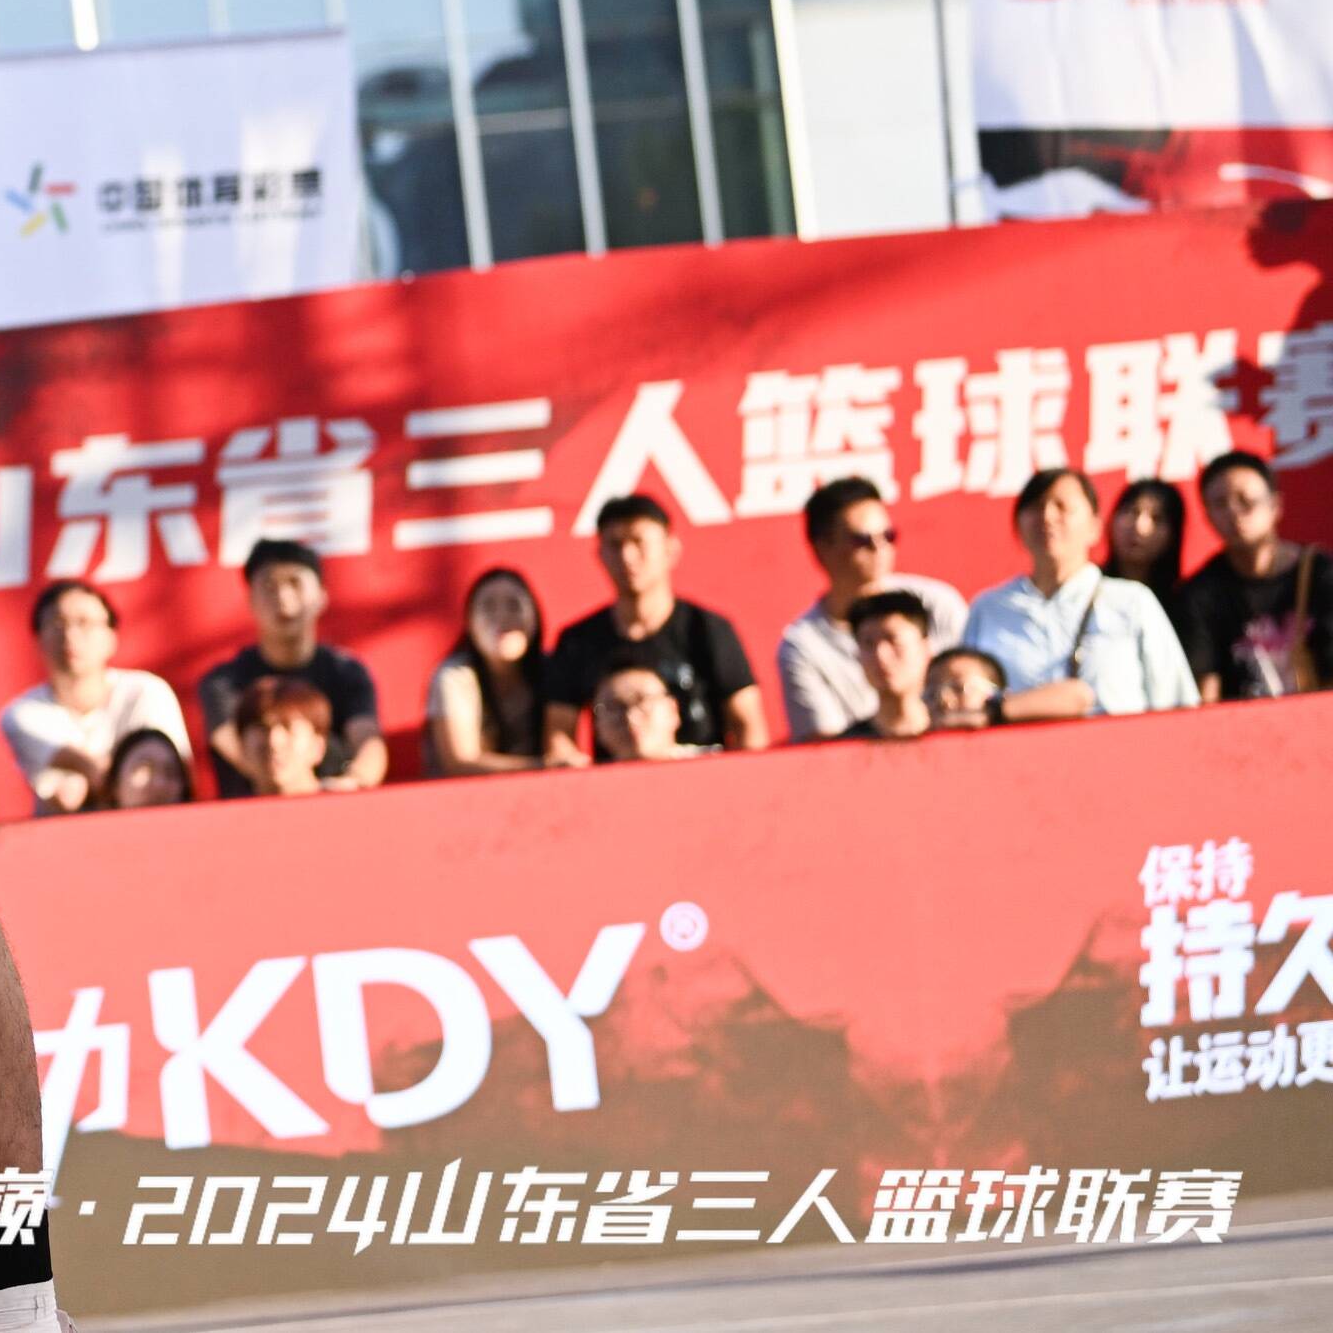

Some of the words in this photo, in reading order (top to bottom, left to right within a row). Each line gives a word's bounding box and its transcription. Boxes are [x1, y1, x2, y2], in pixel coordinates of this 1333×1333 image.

[1139, 836, 1253, 905] 保持
[1139, 891, 1333, 1027] 持久
[147, 921, 647, 1150] KDY
